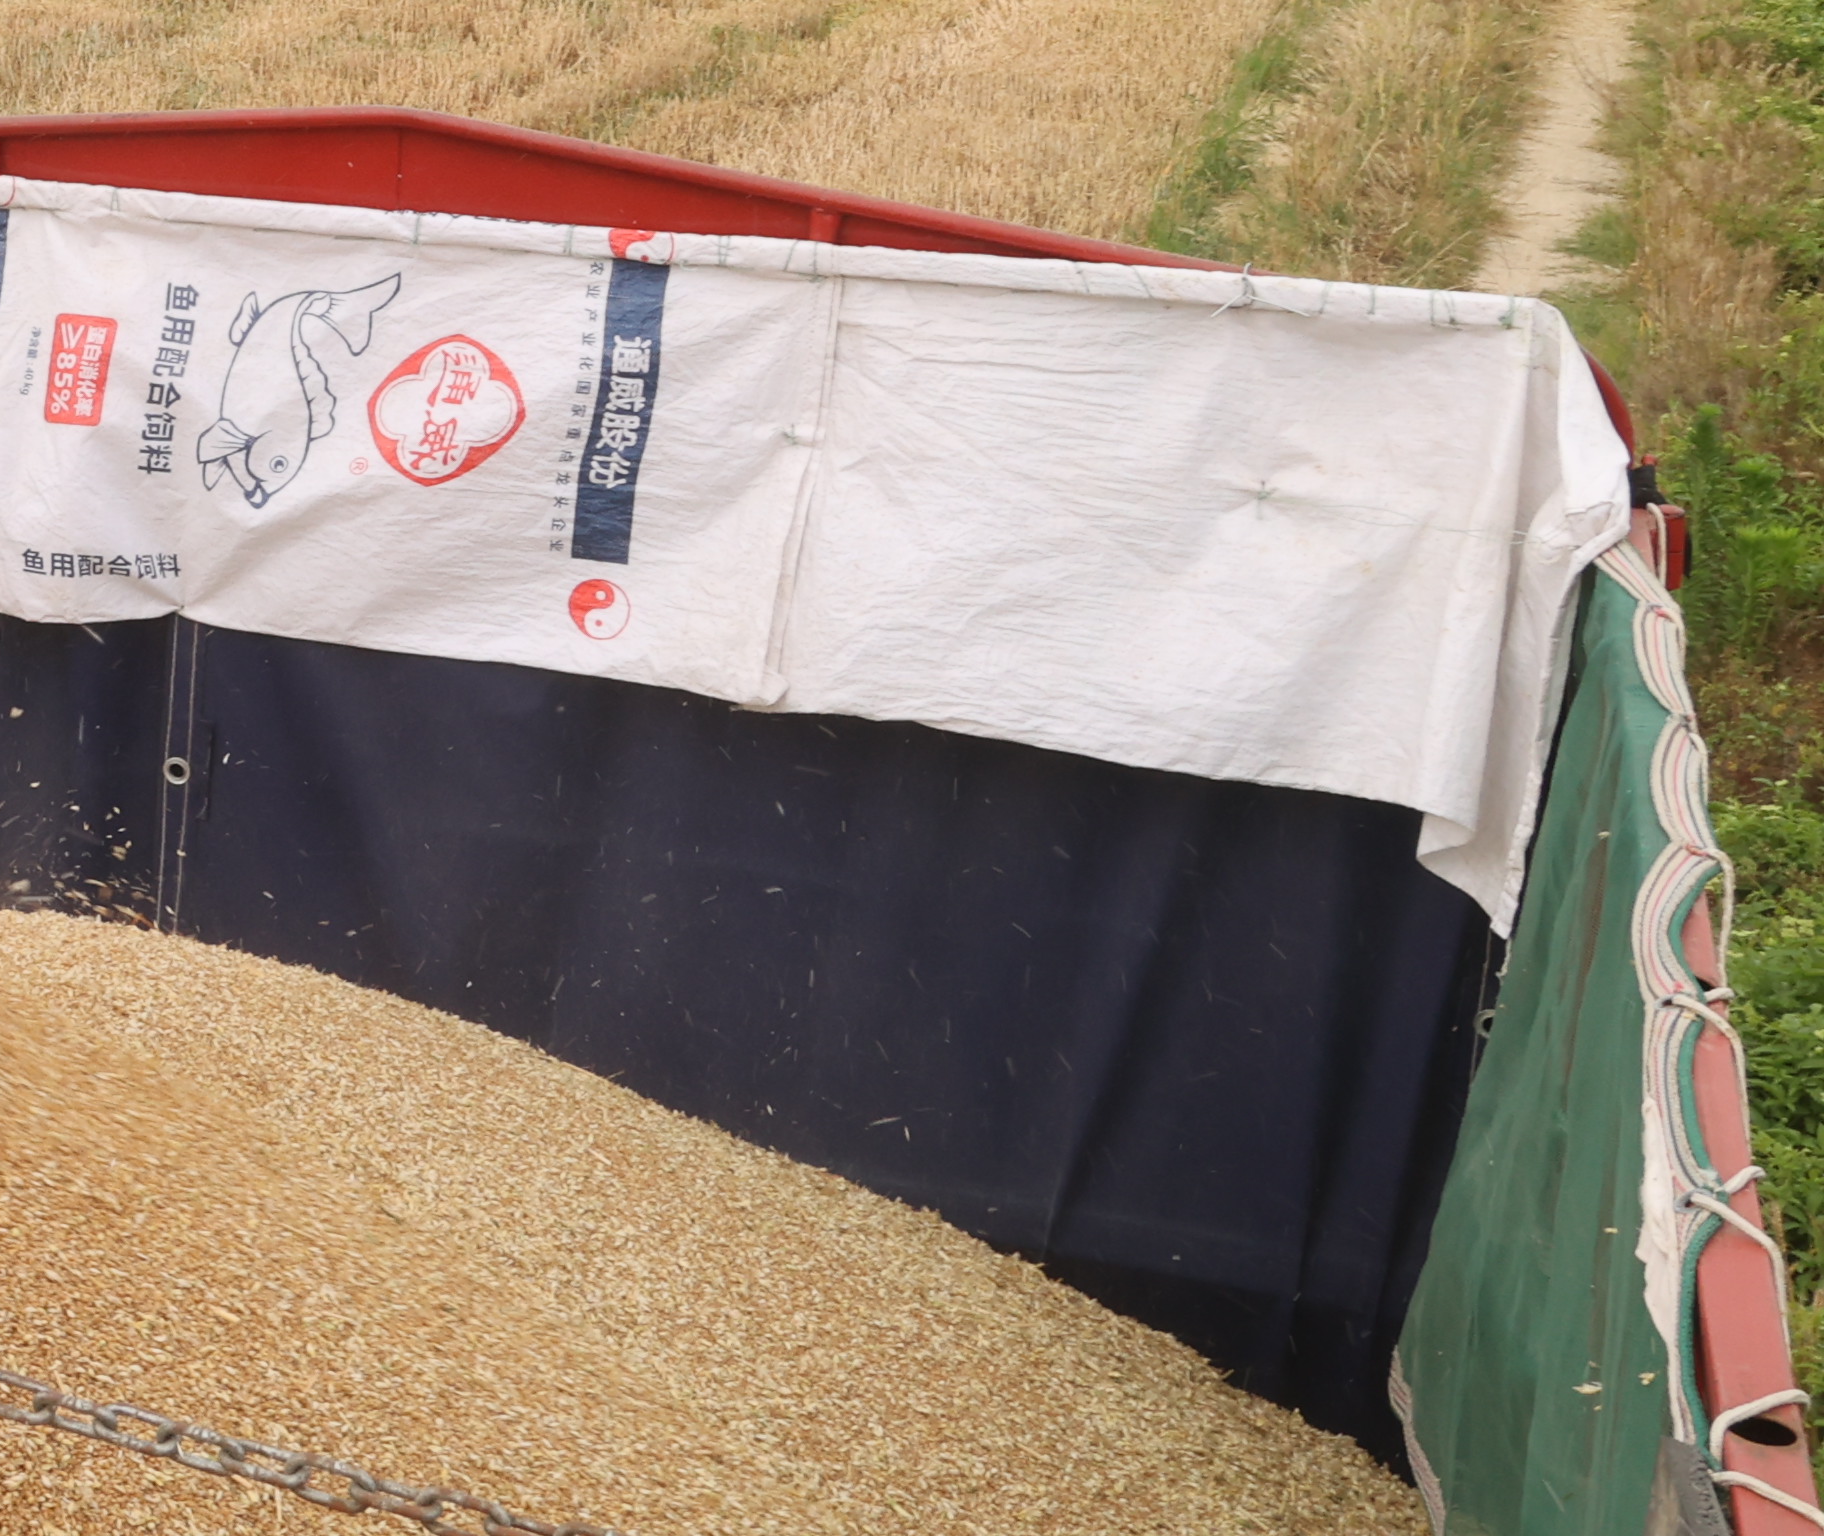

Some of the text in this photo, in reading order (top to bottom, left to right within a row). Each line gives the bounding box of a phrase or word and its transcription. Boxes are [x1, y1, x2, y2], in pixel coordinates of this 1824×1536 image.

[75, 325, 109, 417] 蛋白消化率
[138, 283, 201, 475] 鱼用配合饲料
[550, 261, 604, 552] 农业产业化国家重点龙头企业
[588, 335, 652, 489] 通威股份
[22, 549, 181, 580] 鱼用配合饲料
